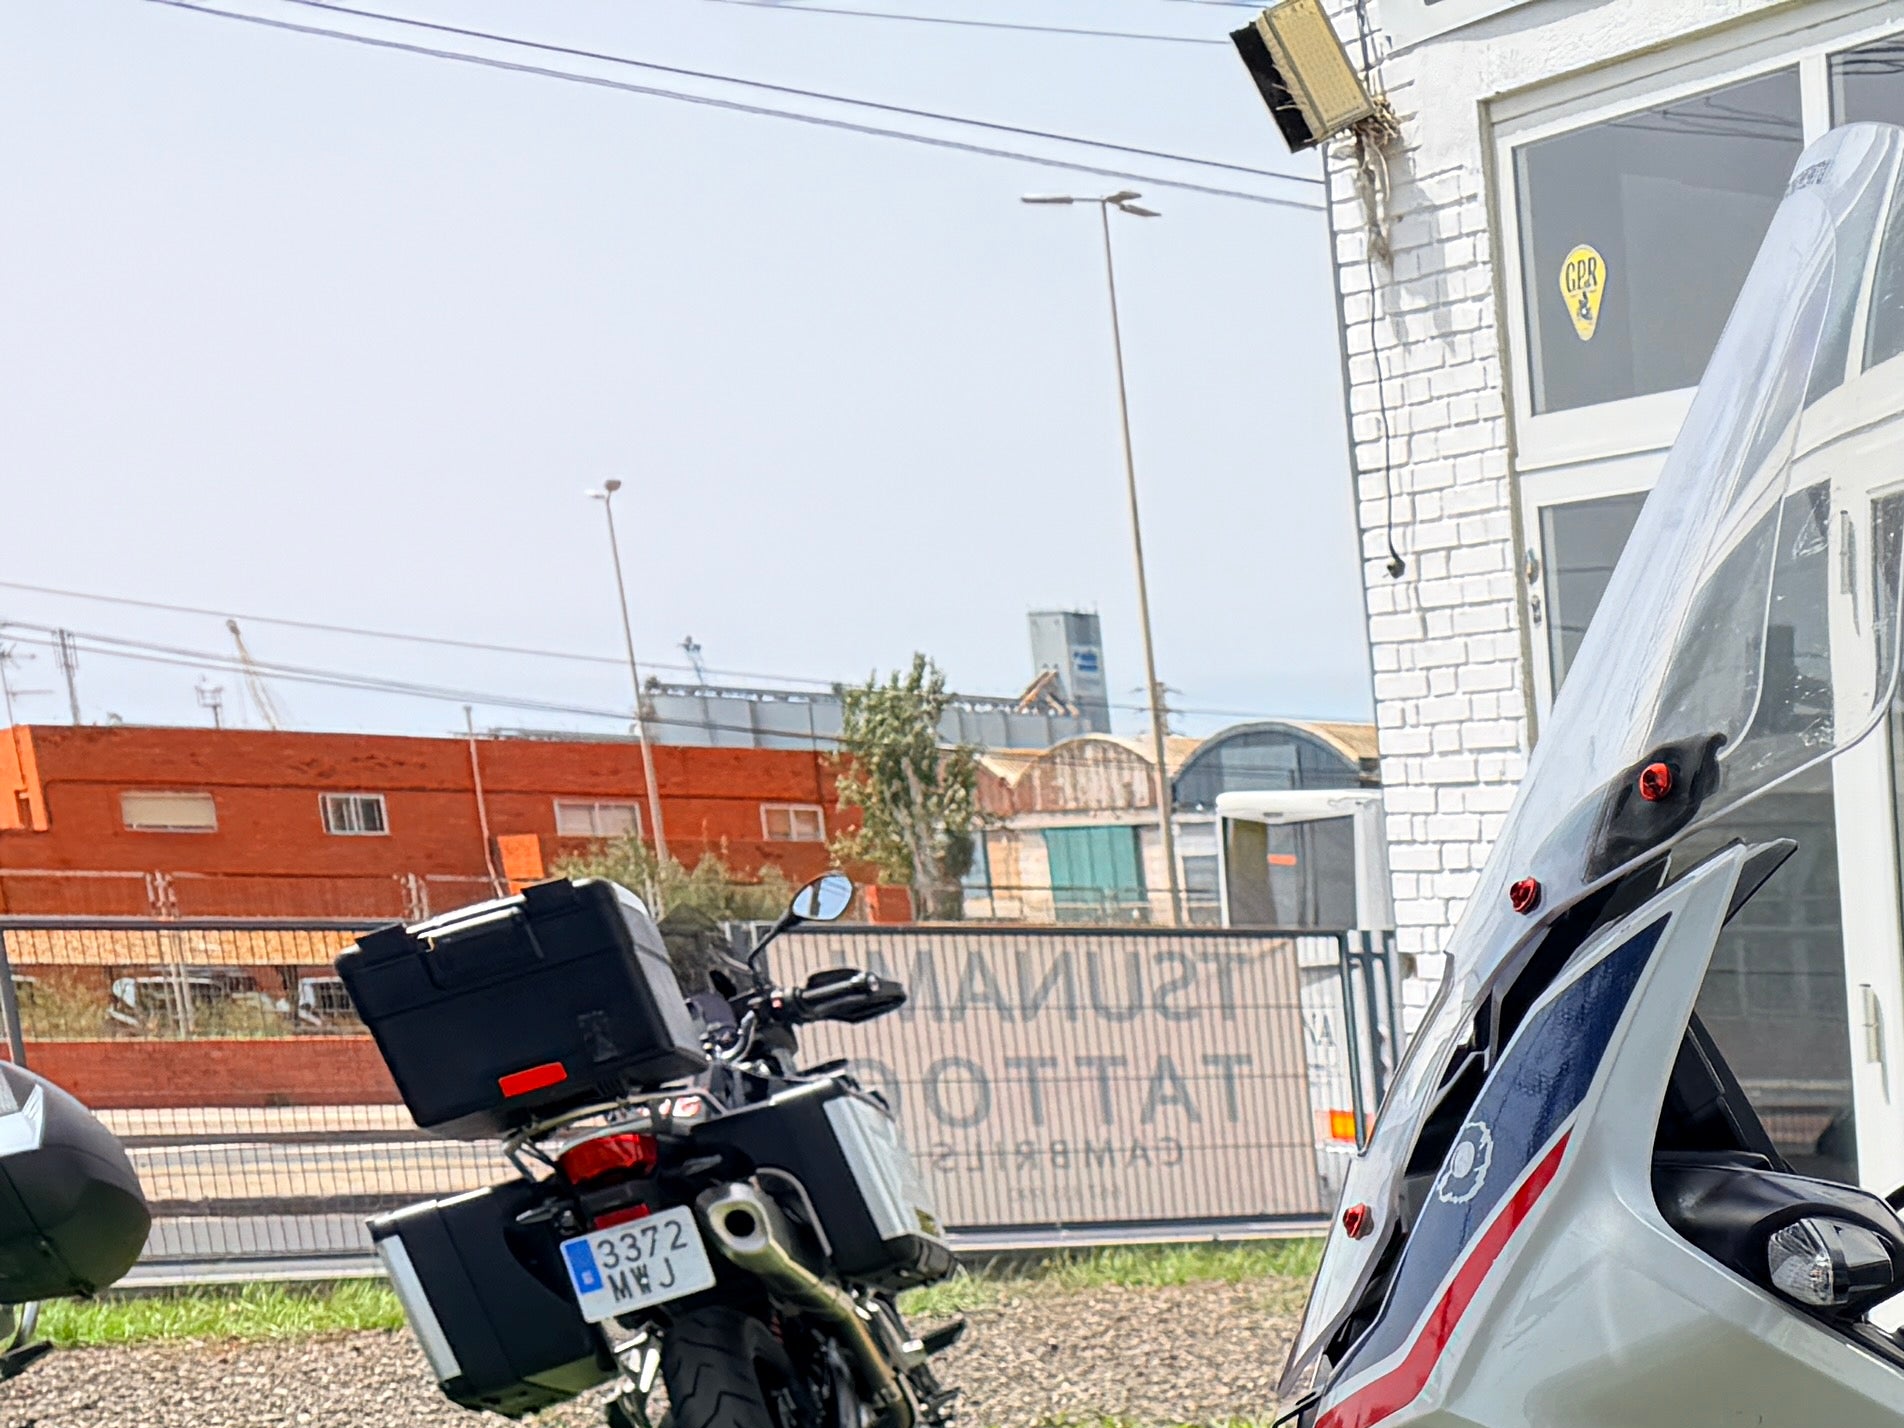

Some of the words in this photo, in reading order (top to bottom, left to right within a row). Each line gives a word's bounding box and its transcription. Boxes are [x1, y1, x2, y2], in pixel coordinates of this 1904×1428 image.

[1565, 256, 1598, 293] GPR
[597, 1220, 688, 1269] 3372
[608, 1257, 677, 1304] MWJ
